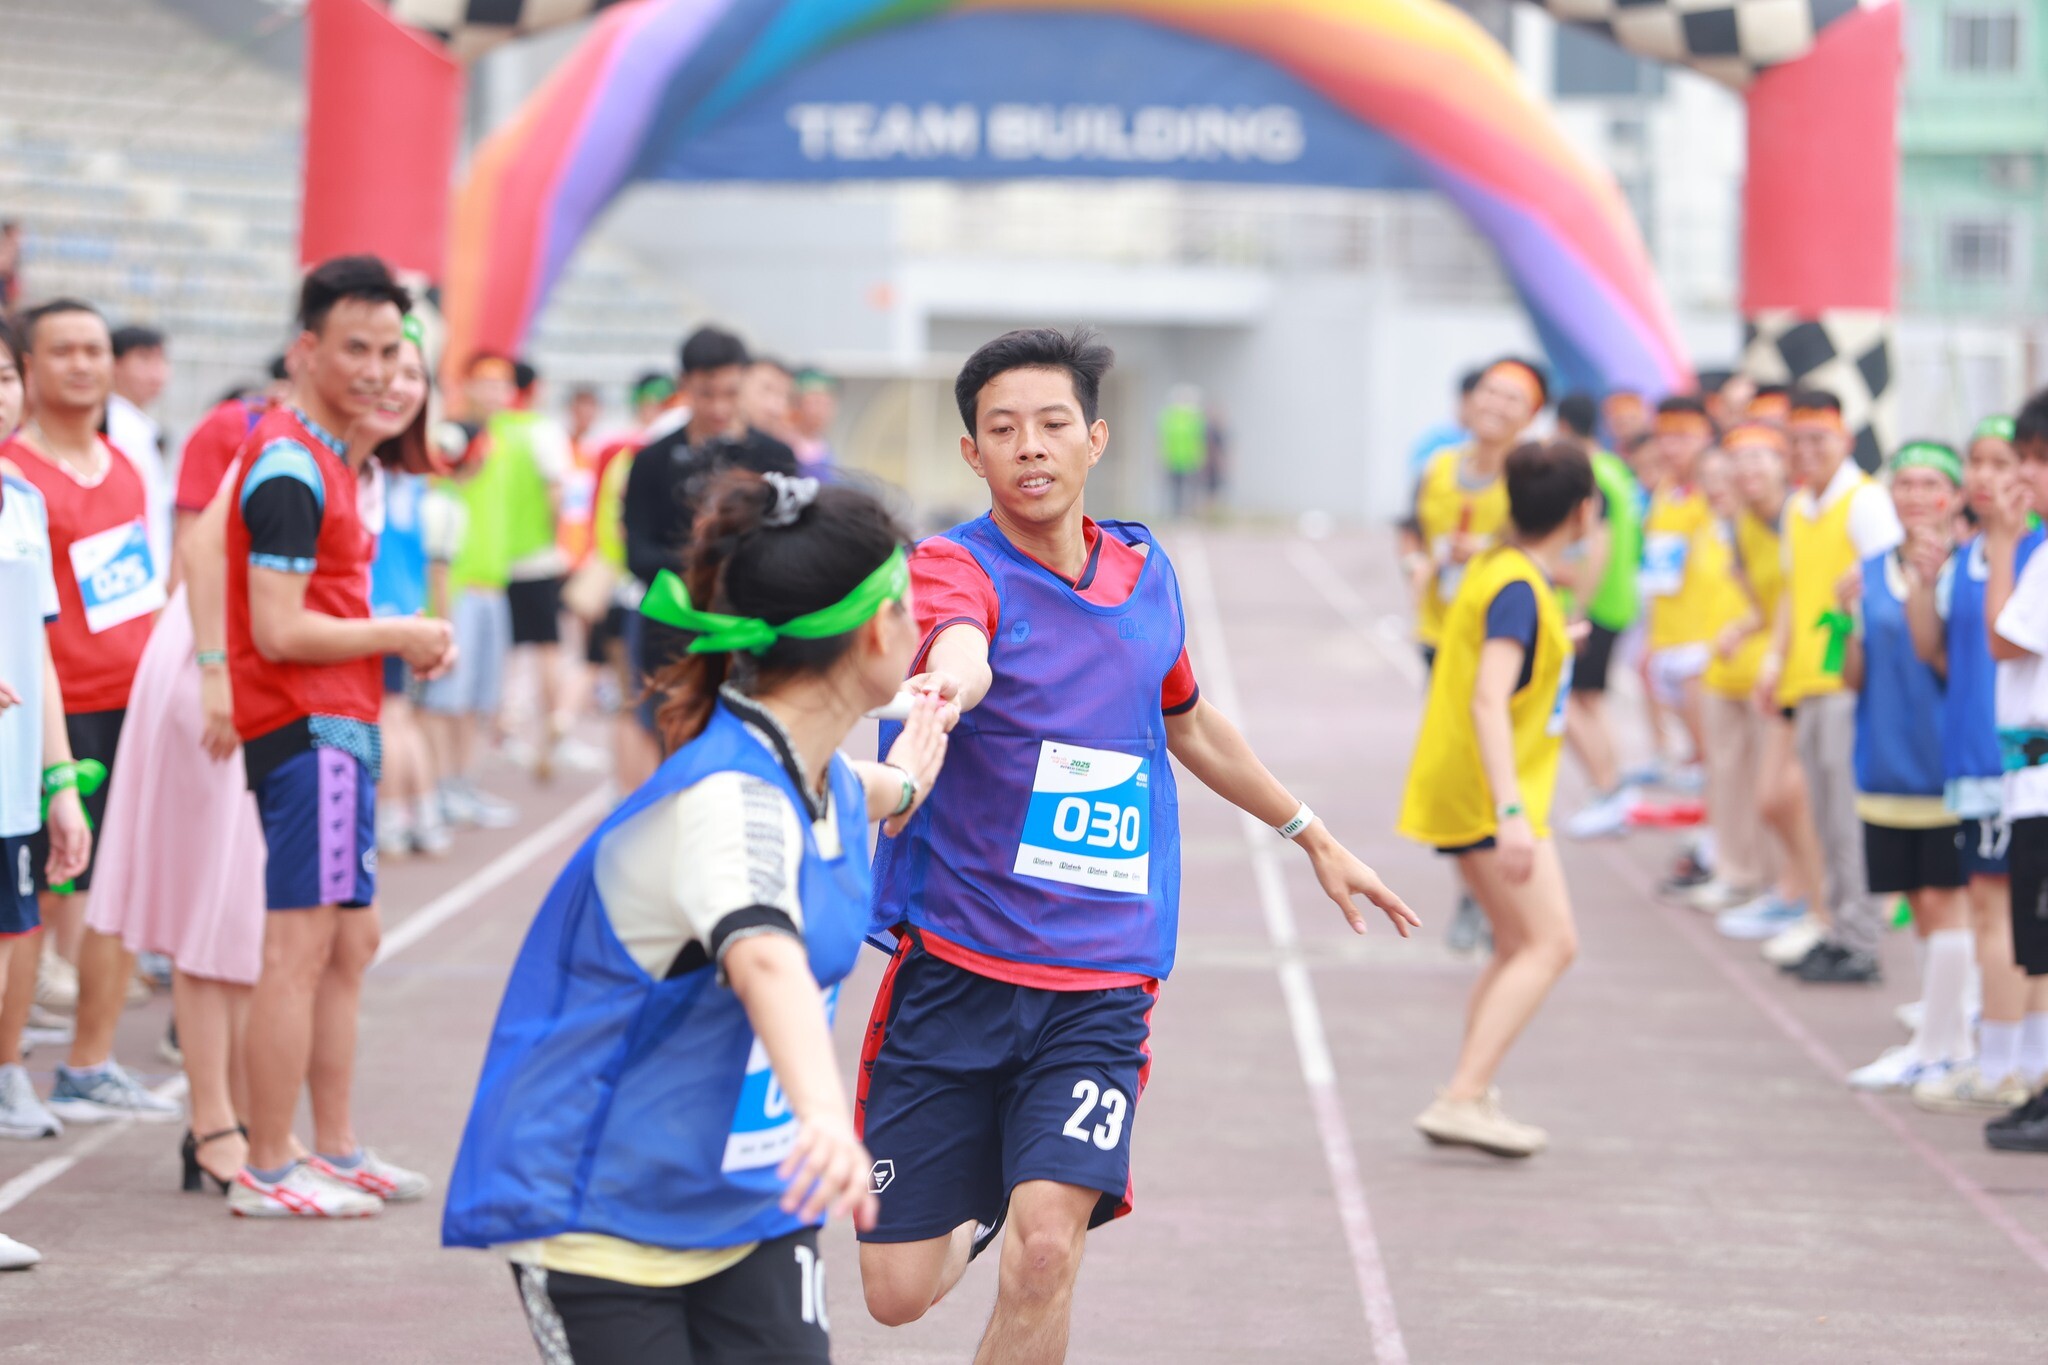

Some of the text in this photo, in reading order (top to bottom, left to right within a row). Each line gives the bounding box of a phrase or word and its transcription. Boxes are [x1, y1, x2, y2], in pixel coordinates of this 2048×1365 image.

[791, 105, 1303, 162] TEAM BUILDING
[91, 553, 147, 601] 025
[1070, 759, 1091, 769] 2025
[1053, 796, 1141, 852] 030
[1062, 1079, 1127, 1151] 23
